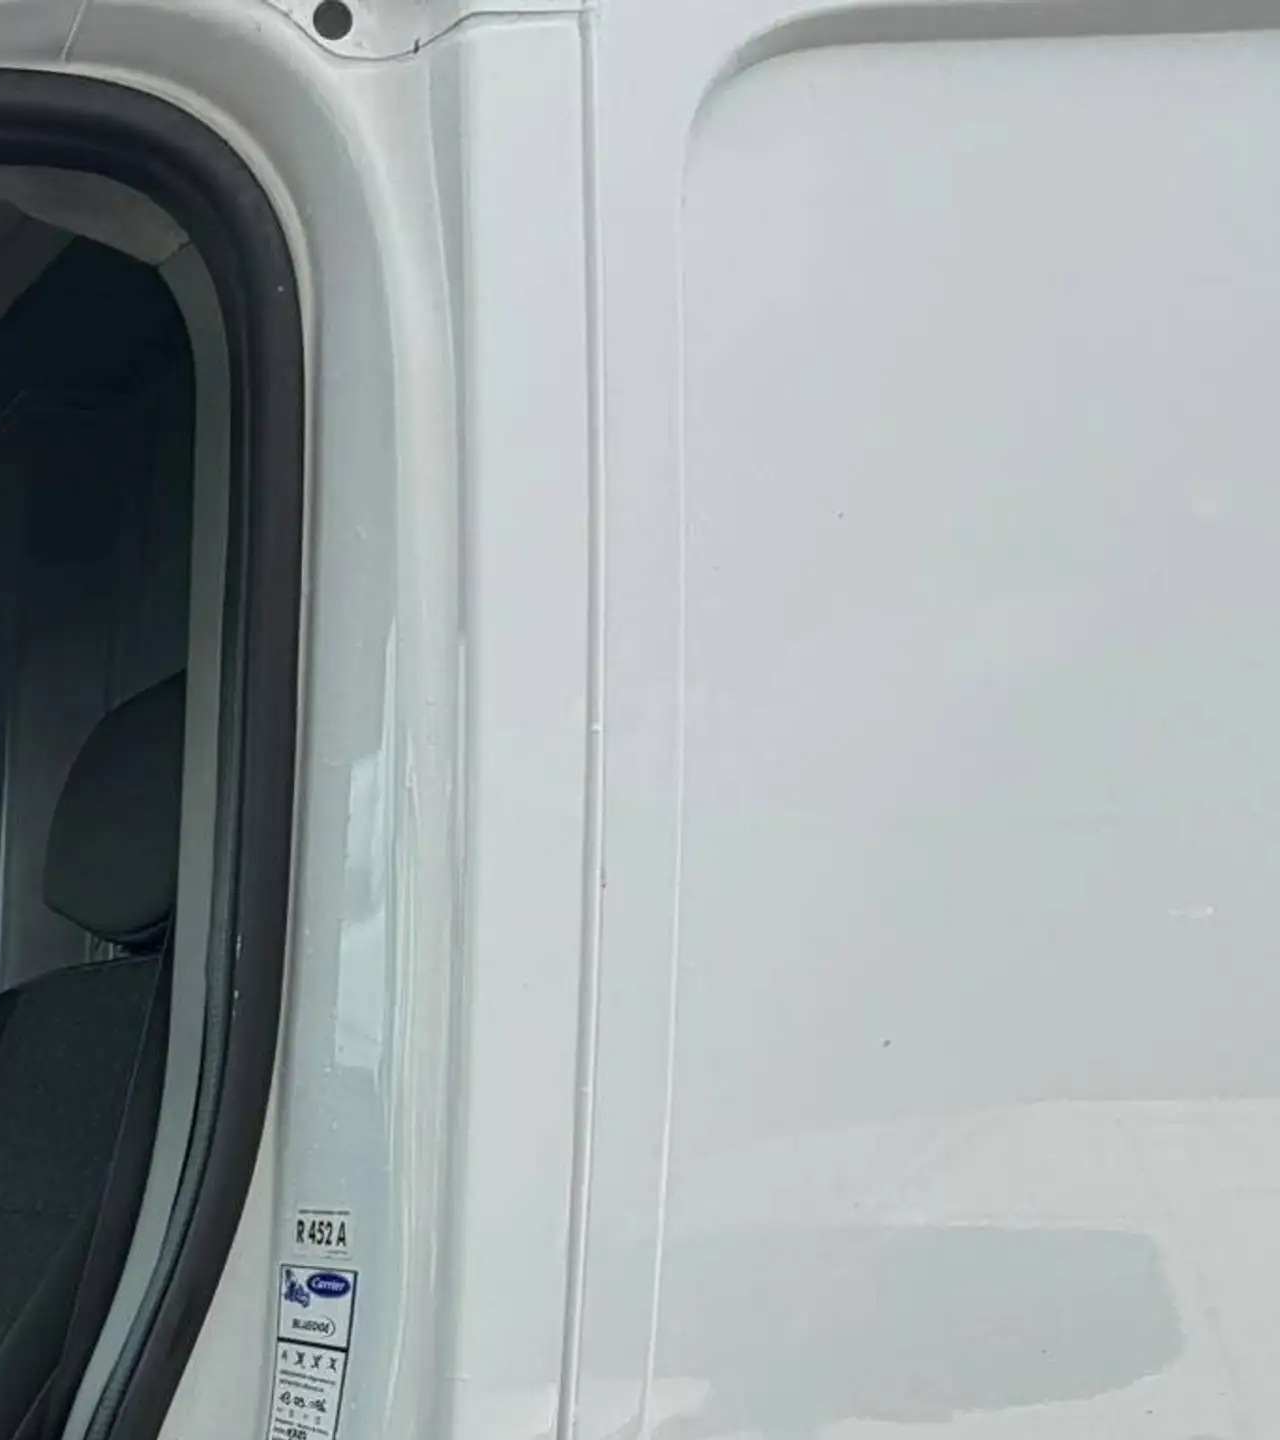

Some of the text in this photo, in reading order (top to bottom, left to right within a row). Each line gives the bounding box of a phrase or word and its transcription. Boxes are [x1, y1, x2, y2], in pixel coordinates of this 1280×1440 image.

[295, 1219, 347, 1247] R 452 A
[310, 1276, 346, 1292] Carrier
